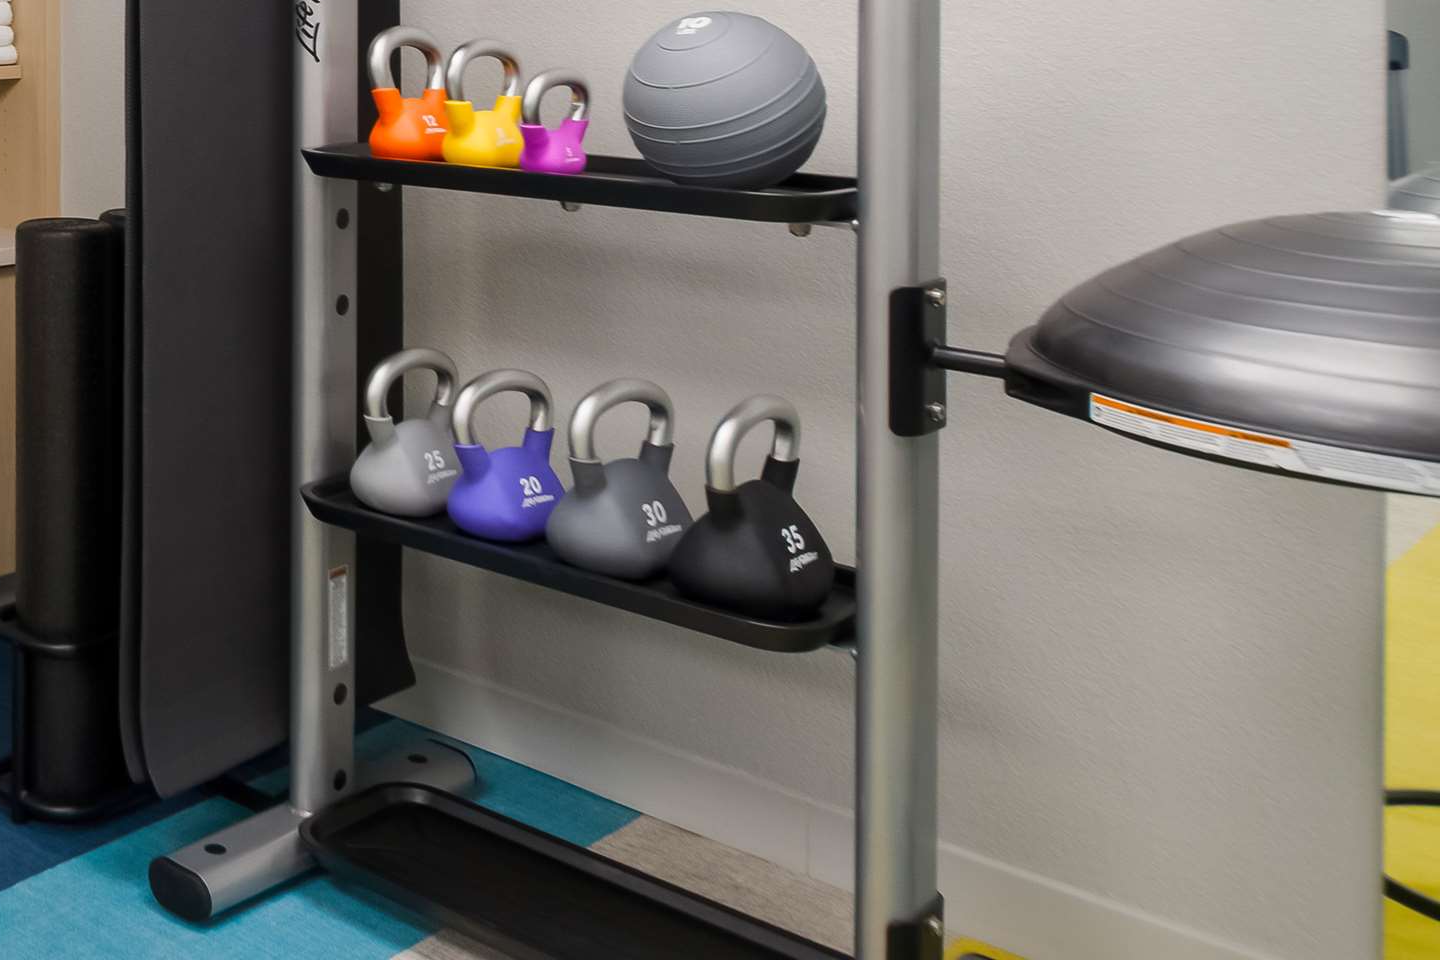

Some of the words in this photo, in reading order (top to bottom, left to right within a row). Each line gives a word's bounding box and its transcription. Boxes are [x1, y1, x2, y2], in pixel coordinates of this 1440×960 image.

[424, 450, 445, 470] 25
[519, 475, 542, 497] 20
[641, 500, 667, 527] 30
[781, 524, 805, 554] 35
